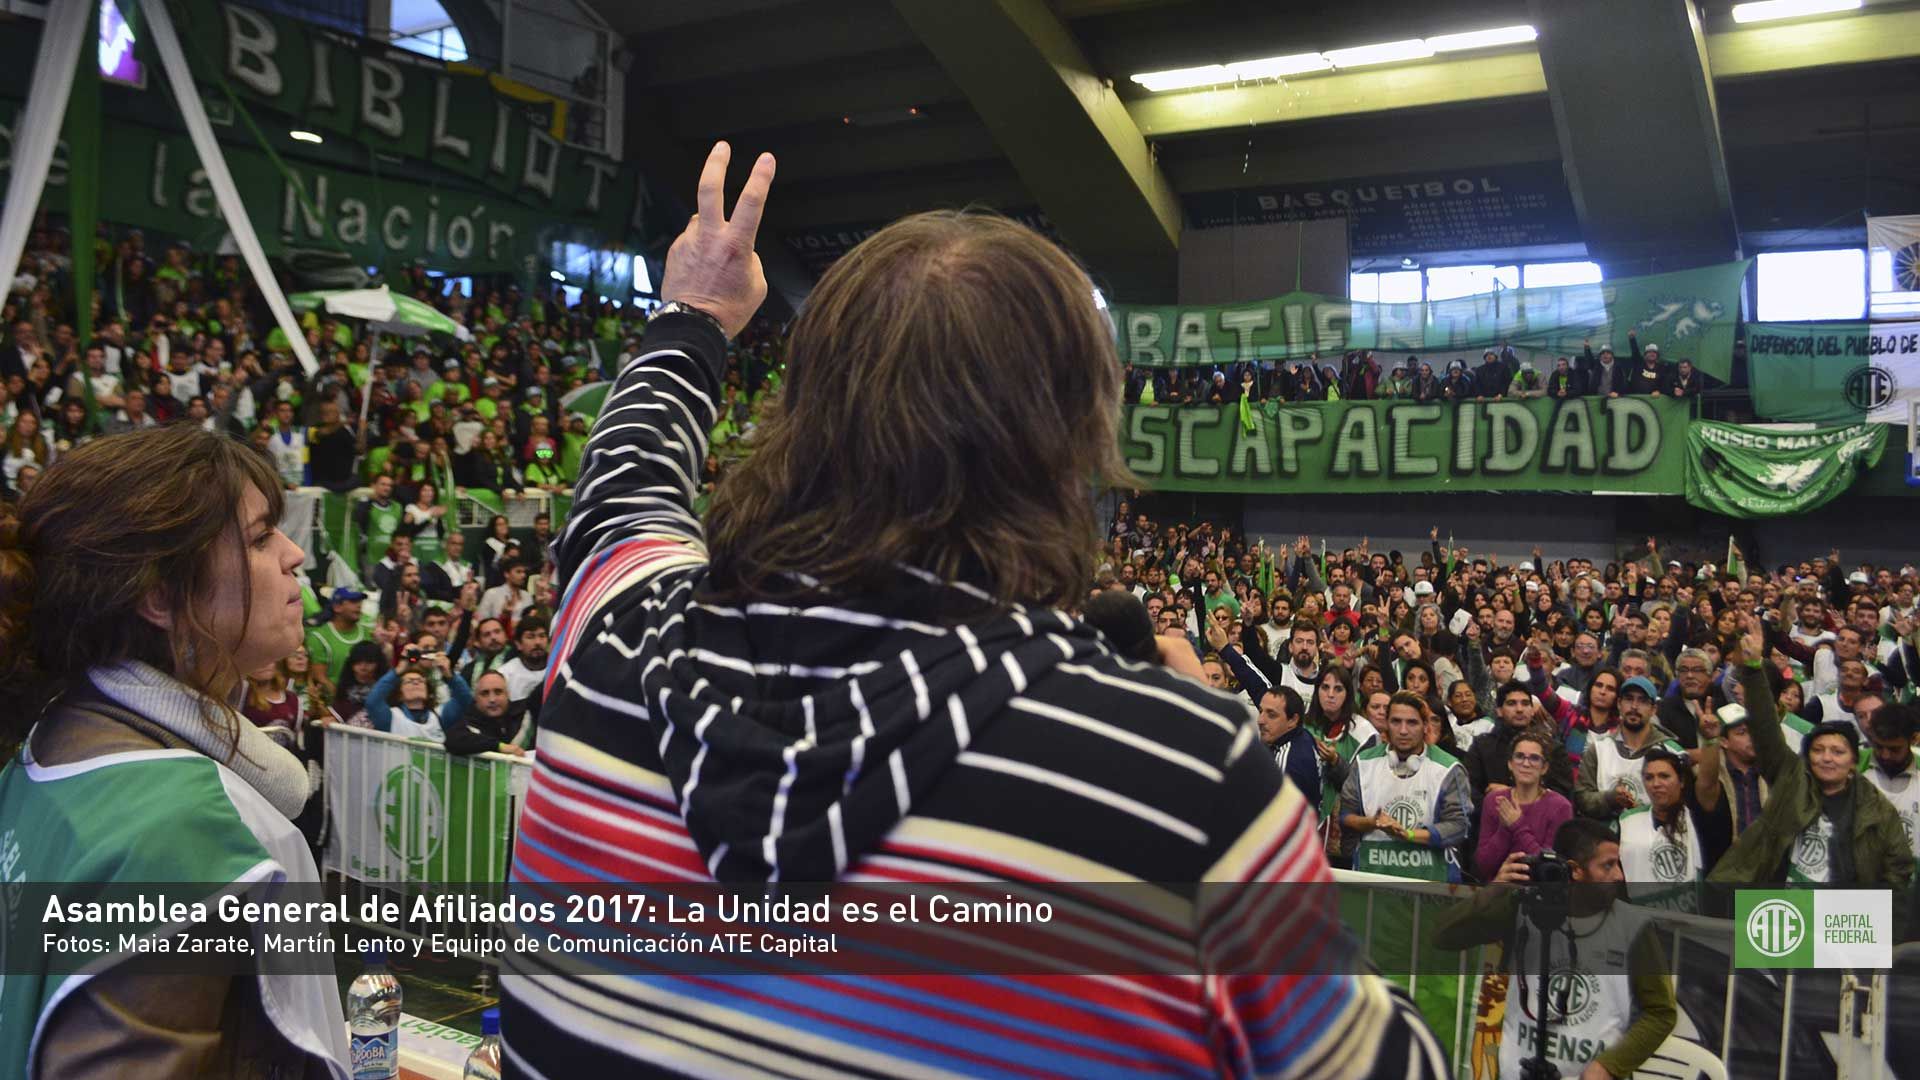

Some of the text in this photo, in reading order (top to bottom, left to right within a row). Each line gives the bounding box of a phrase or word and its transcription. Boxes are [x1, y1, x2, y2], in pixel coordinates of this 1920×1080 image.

[1257, 176, 1501, 211] BASQUETBOL
[1752, 334, 1919, 358] DEFENSOR DEL PUEBLO DE
[1128, 397, 1662, 474] SCAPACIDAD
[1701, 425, 1769, 449] MUSEO
[1368, 848, 1433, 867] ENACOM
[1517, 1020, 1605, 1064] PRENSA
